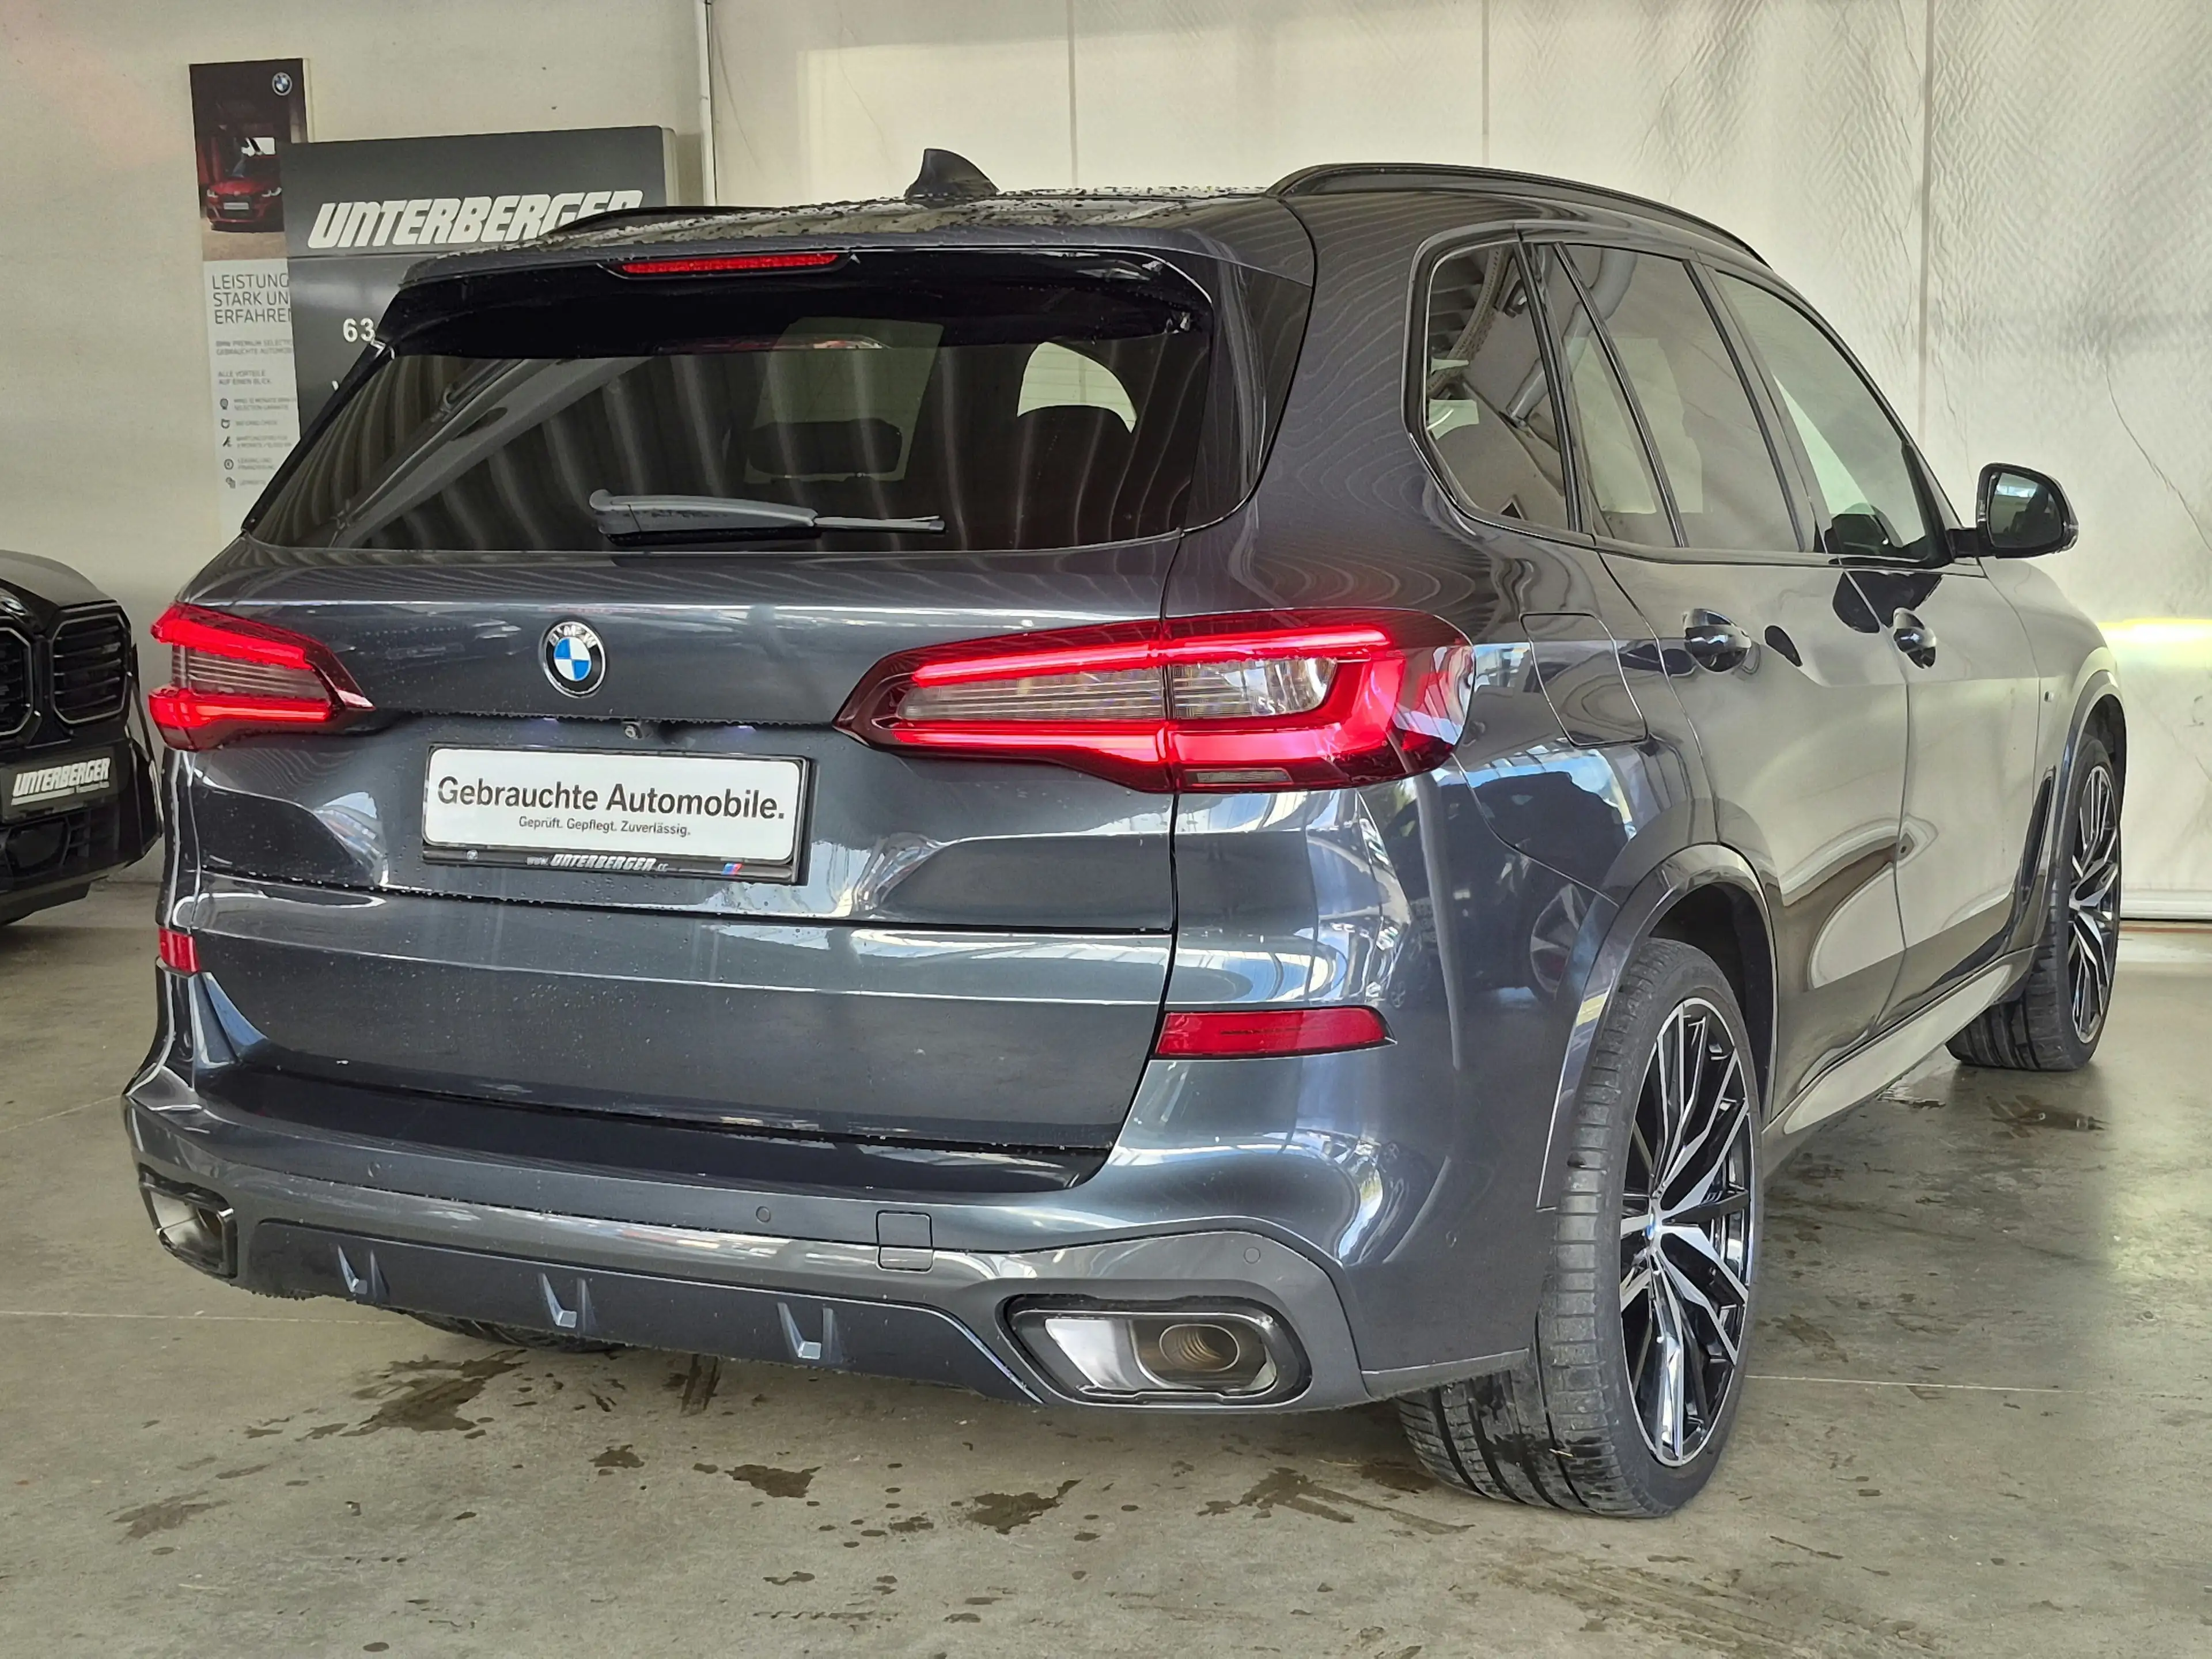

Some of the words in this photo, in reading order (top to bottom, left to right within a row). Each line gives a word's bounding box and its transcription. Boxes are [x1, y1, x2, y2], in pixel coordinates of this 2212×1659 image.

[212, 273, 289, 289] LEISTUNG
[213, 291, 262, 306] STARK
[12, 757, 111, 798] UNTERBERGER
[437, 775, 599, 810] Gebrauchte
[605, 783, 784, 819] Automobile.
[519, 816, 562, 830] Geprüft.
[567, 818, 616, 834] Gepflegt.
[620, 820, 691, 838] Zuverlässig.
